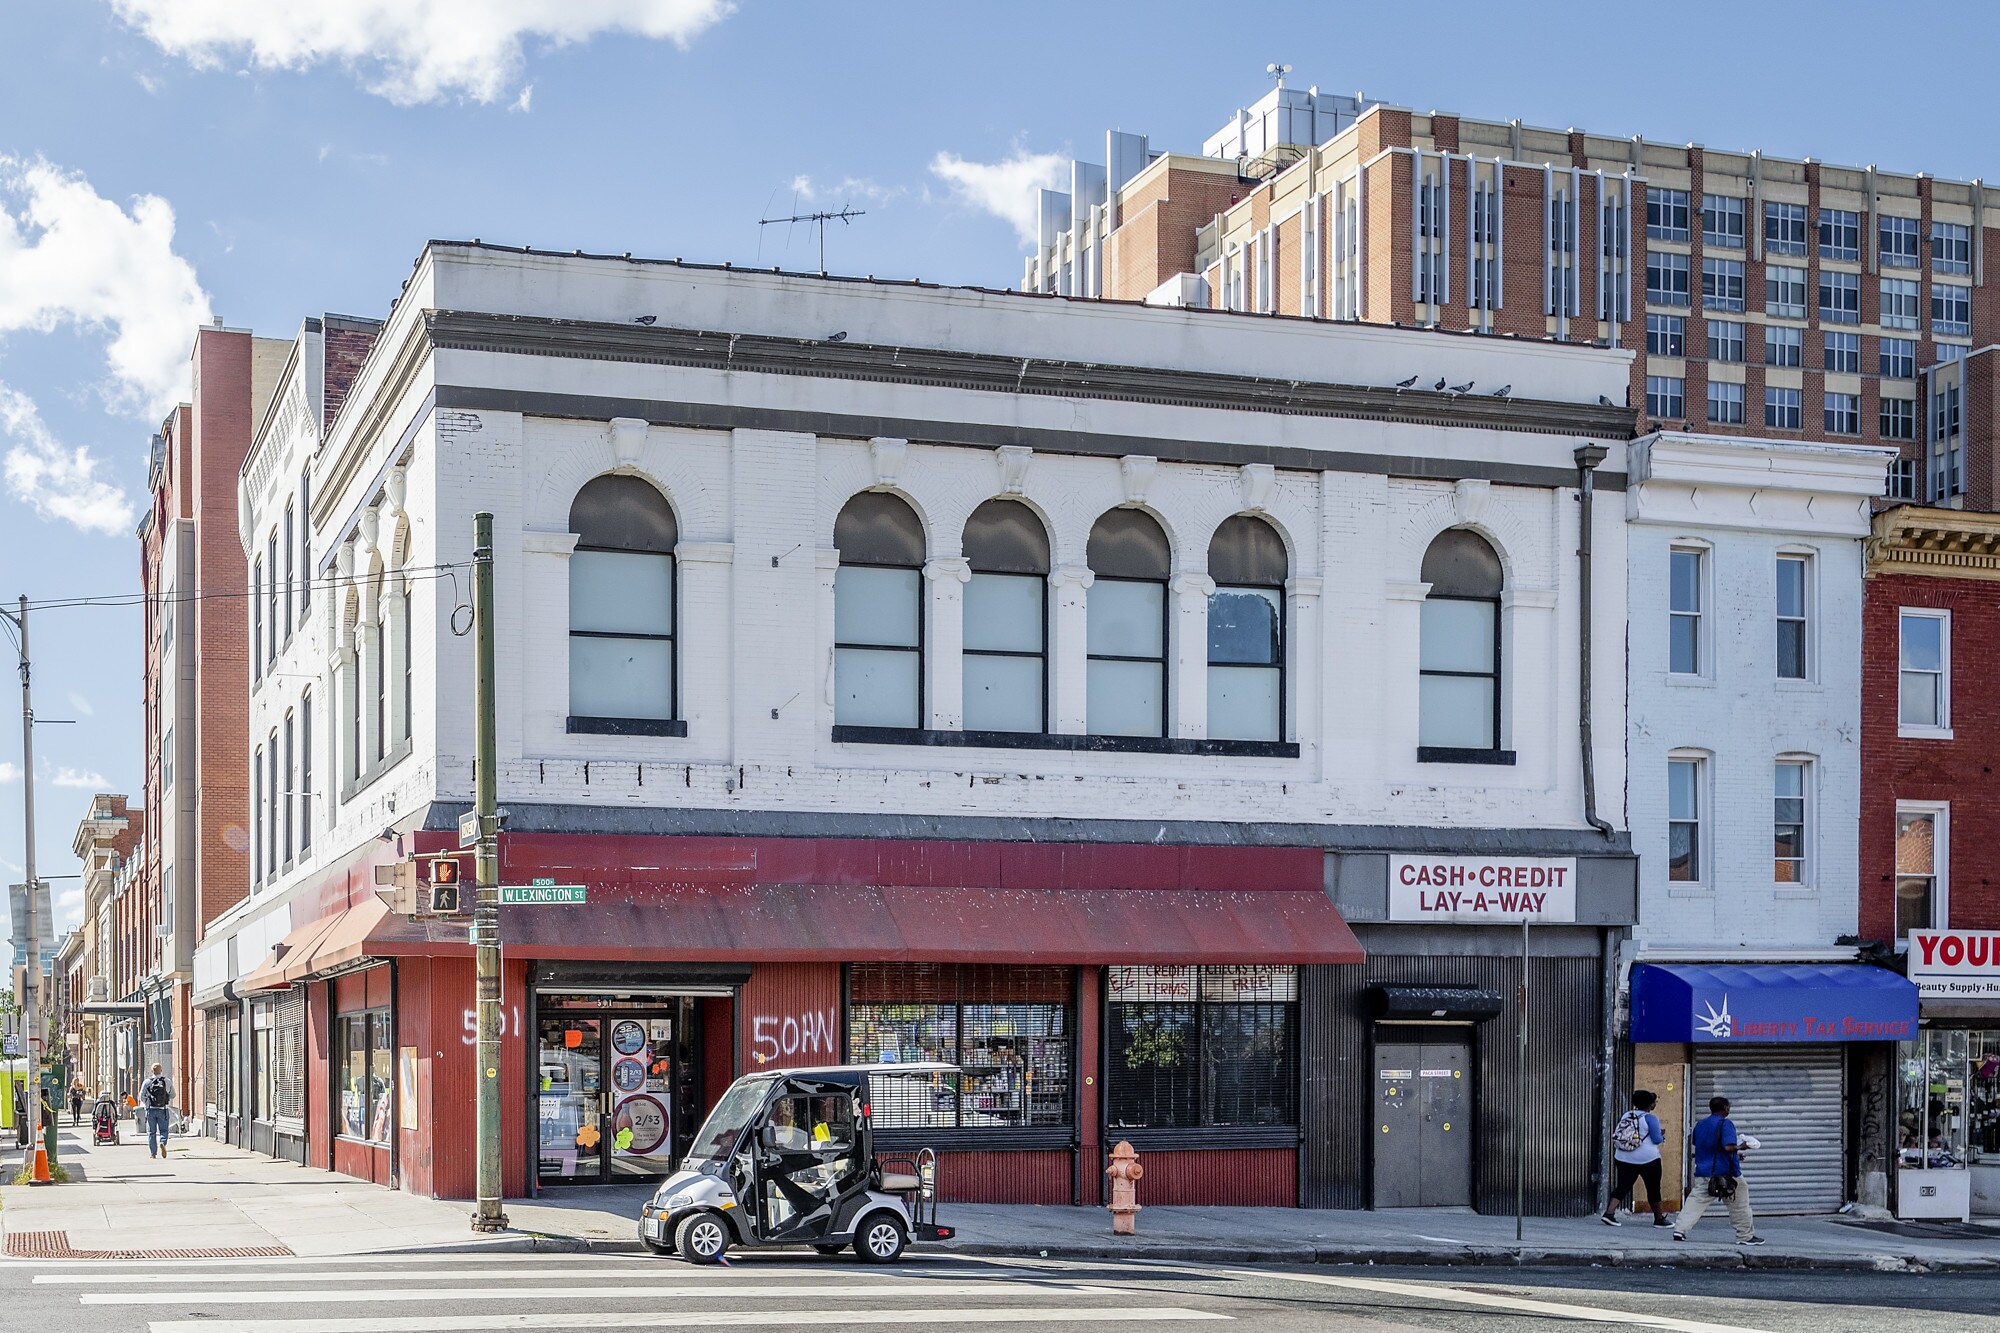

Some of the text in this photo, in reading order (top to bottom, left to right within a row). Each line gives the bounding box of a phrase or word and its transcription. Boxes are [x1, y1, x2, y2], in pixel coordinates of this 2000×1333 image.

[1420, 891, 1547, 912] LAY-A-WAY
[1145, 965, 1187, 977] CREDIT
[1109, 967, 1135, 991] EZ
[1145, 983, 1188, 996] TERMS
[1949, 983, 1981, 993] Supply
[1986, 983, 2000, 992] Hu
[1803, 1017, 1837, 1036] TAX
[635, 1115, 660, 1127] 2/$3
